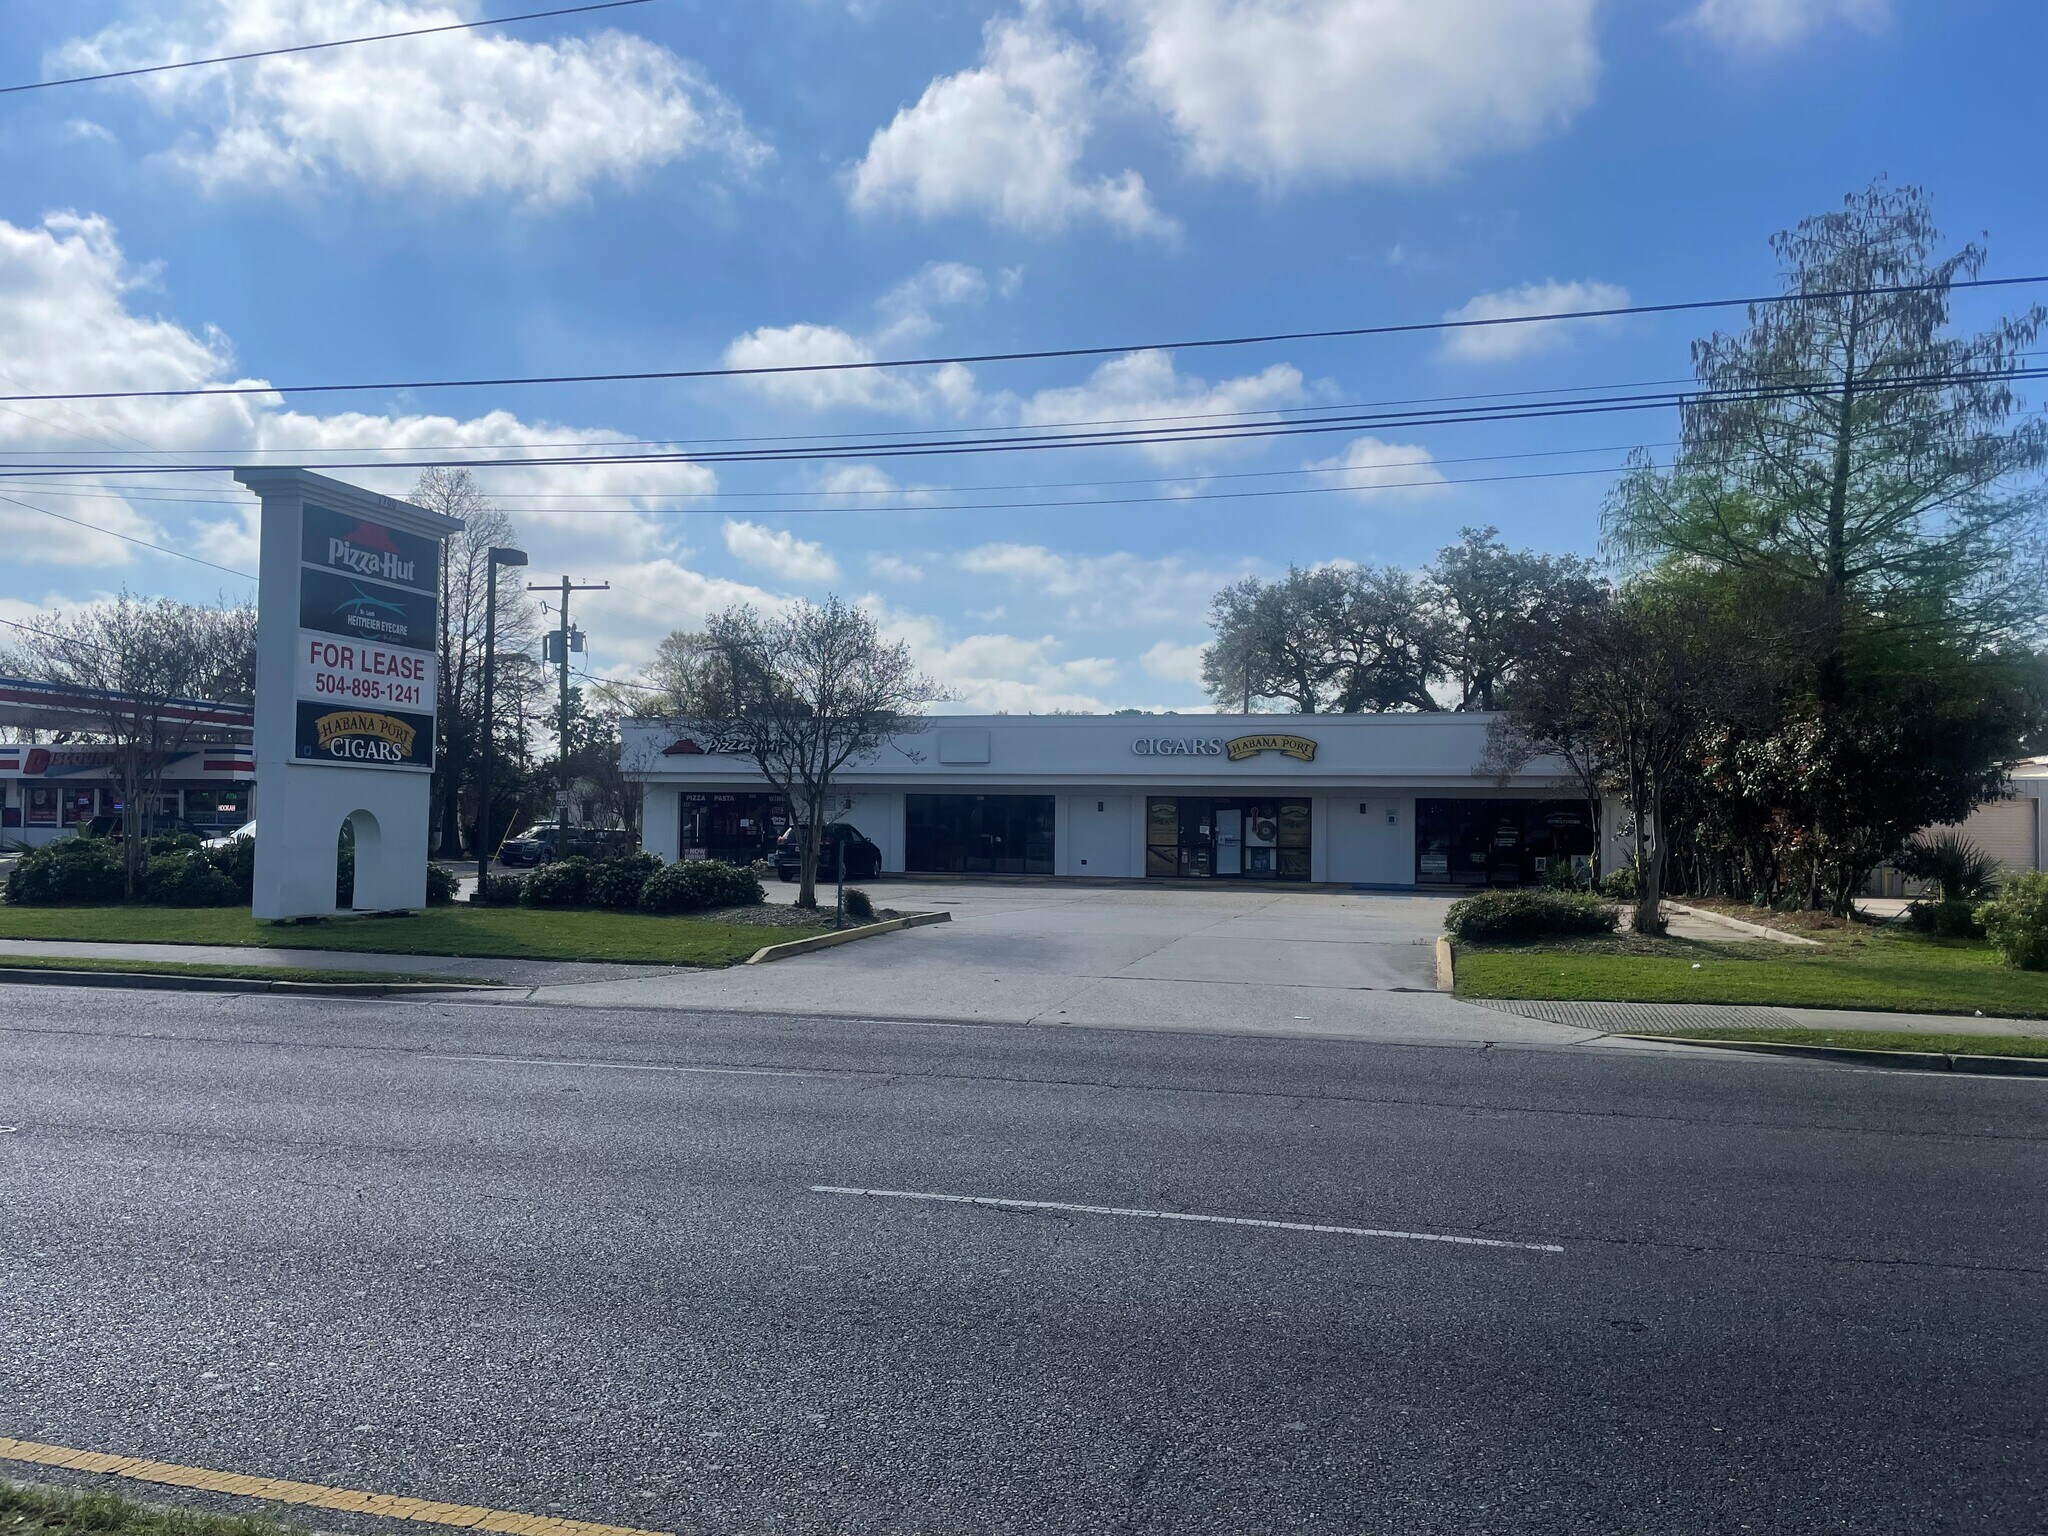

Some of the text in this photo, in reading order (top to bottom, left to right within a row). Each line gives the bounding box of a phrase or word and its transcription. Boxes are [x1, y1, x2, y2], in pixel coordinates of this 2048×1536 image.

[328, 537, 415, 581] Pizza Hut
[347, 614, 408, 636] HEITMEIER EYECARE
[310, 641, 425, 681] FOR LEASE
[316, 672, 421, 705] 504-895-1241
[321, 715, 411, 744] HABANA PORT
[330, 737, 402, 761] CIGARS
[1131, 736, 1311, 755] CIGARS HABANA PORT
